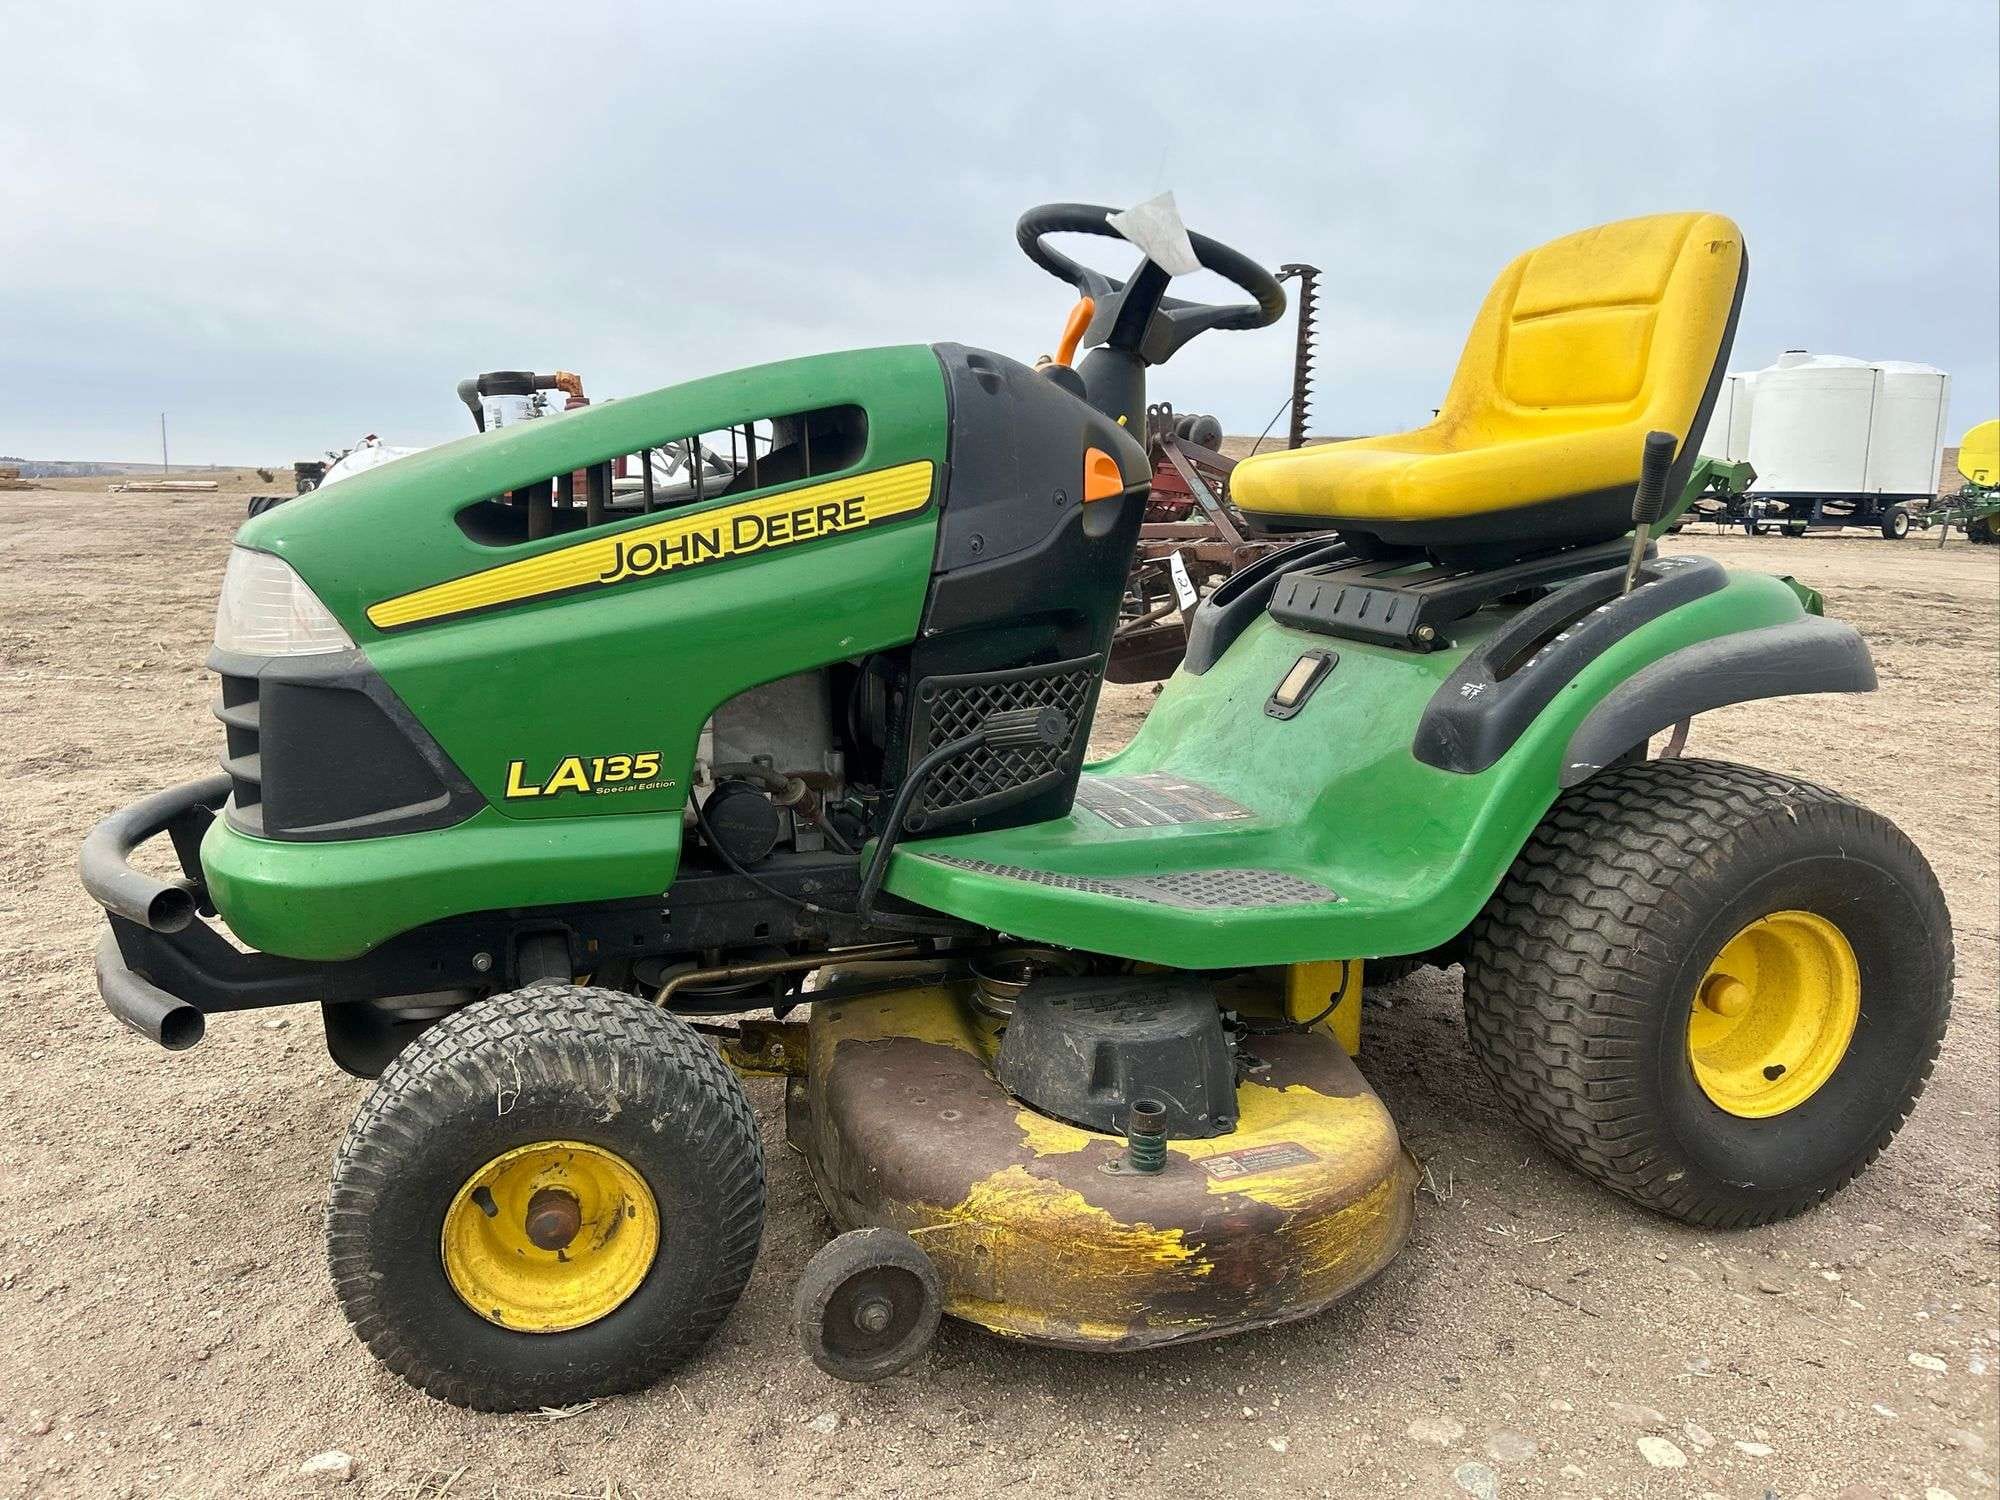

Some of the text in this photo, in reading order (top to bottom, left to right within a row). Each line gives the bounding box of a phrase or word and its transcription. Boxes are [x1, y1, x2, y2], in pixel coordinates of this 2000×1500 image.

[600, 496, 866, 581] JOHN DEERE
[595, 780, 676, 795] Special Edition
